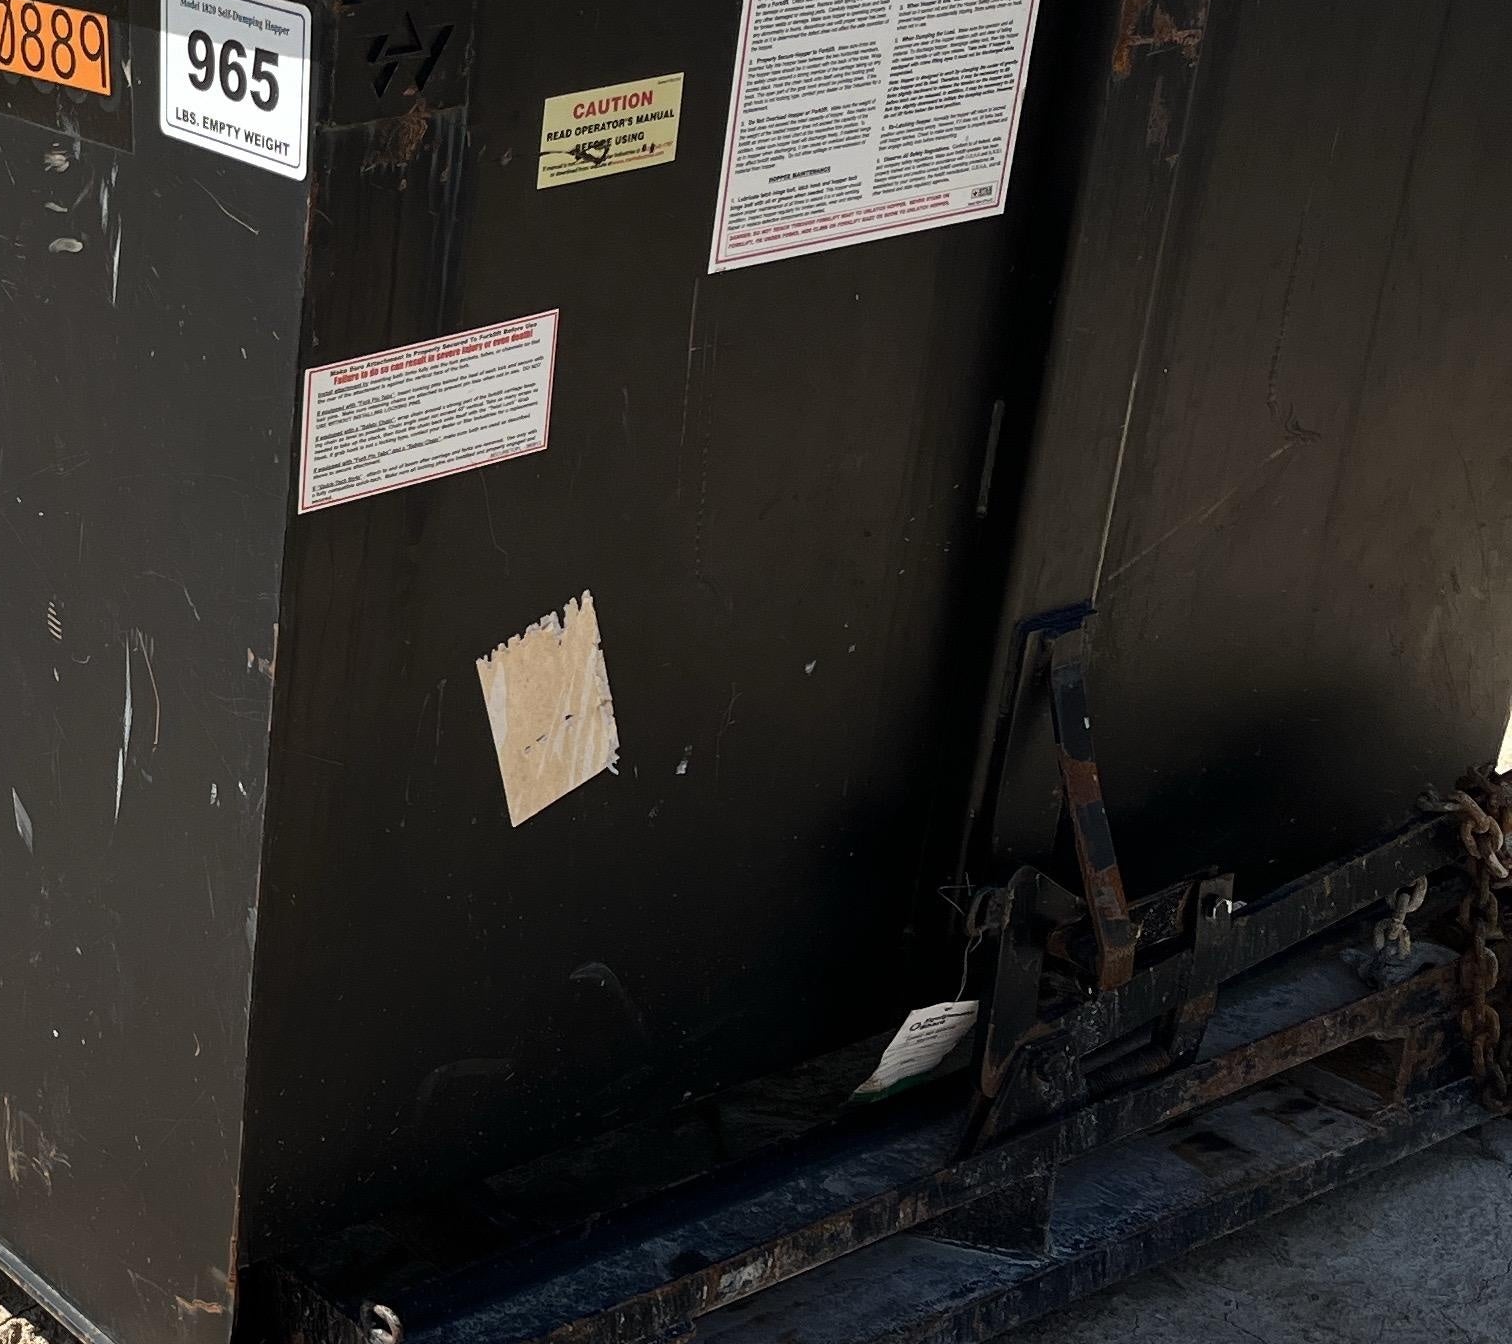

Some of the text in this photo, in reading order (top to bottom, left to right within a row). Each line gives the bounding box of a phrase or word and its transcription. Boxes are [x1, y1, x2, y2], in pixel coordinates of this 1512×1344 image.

[218, 7, 263, 31] Self-Dumping
[265, 19, 290, 36] Hopper
[188, 29, 280, 112] 965
[572, 90, 653, 120] CAUTION
[175, 106, 290, 157] LBS. EMPTY WEIGHT
[546, 109, 675, 142] READ OPERATOR'S MANUAL
[615, 131, 645, 147] USING
